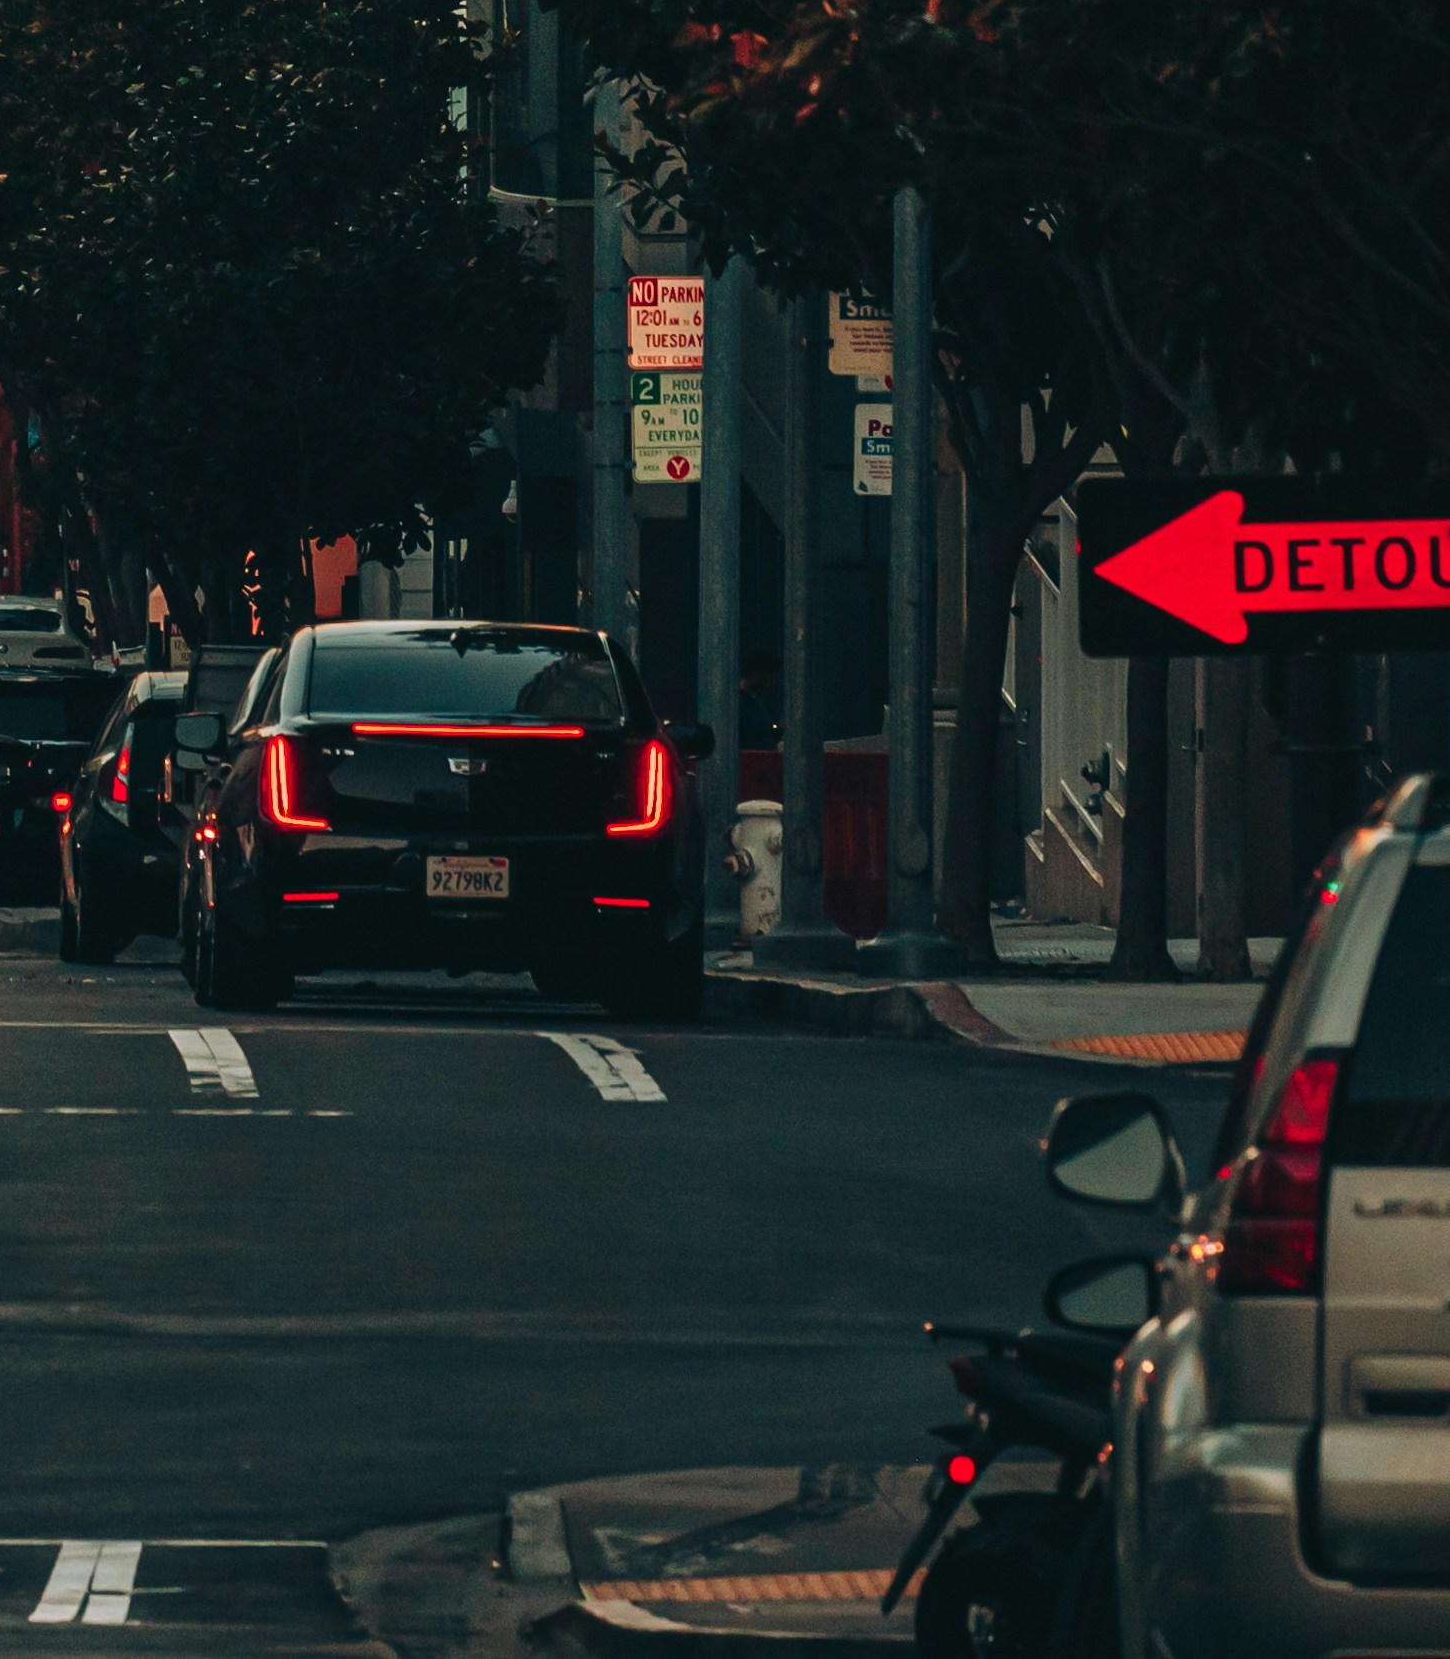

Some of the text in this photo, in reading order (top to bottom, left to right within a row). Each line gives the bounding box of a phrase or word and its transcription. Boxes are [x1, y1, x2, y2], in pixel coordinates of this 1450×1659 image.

[632, 280, 704, 303] NO PARKIN
[645, 334, 704, 348] TUESDAY
[637, 355, 667, 365] STREET
[639, 377, 701, 401] 2 HOU
[663, 393, 700, 404] PARKI
[648, 430, 700, 442] EVERYDA
[868, 419, 893, 437] Pa
[1234, 536, 1450, 593] DETOU
